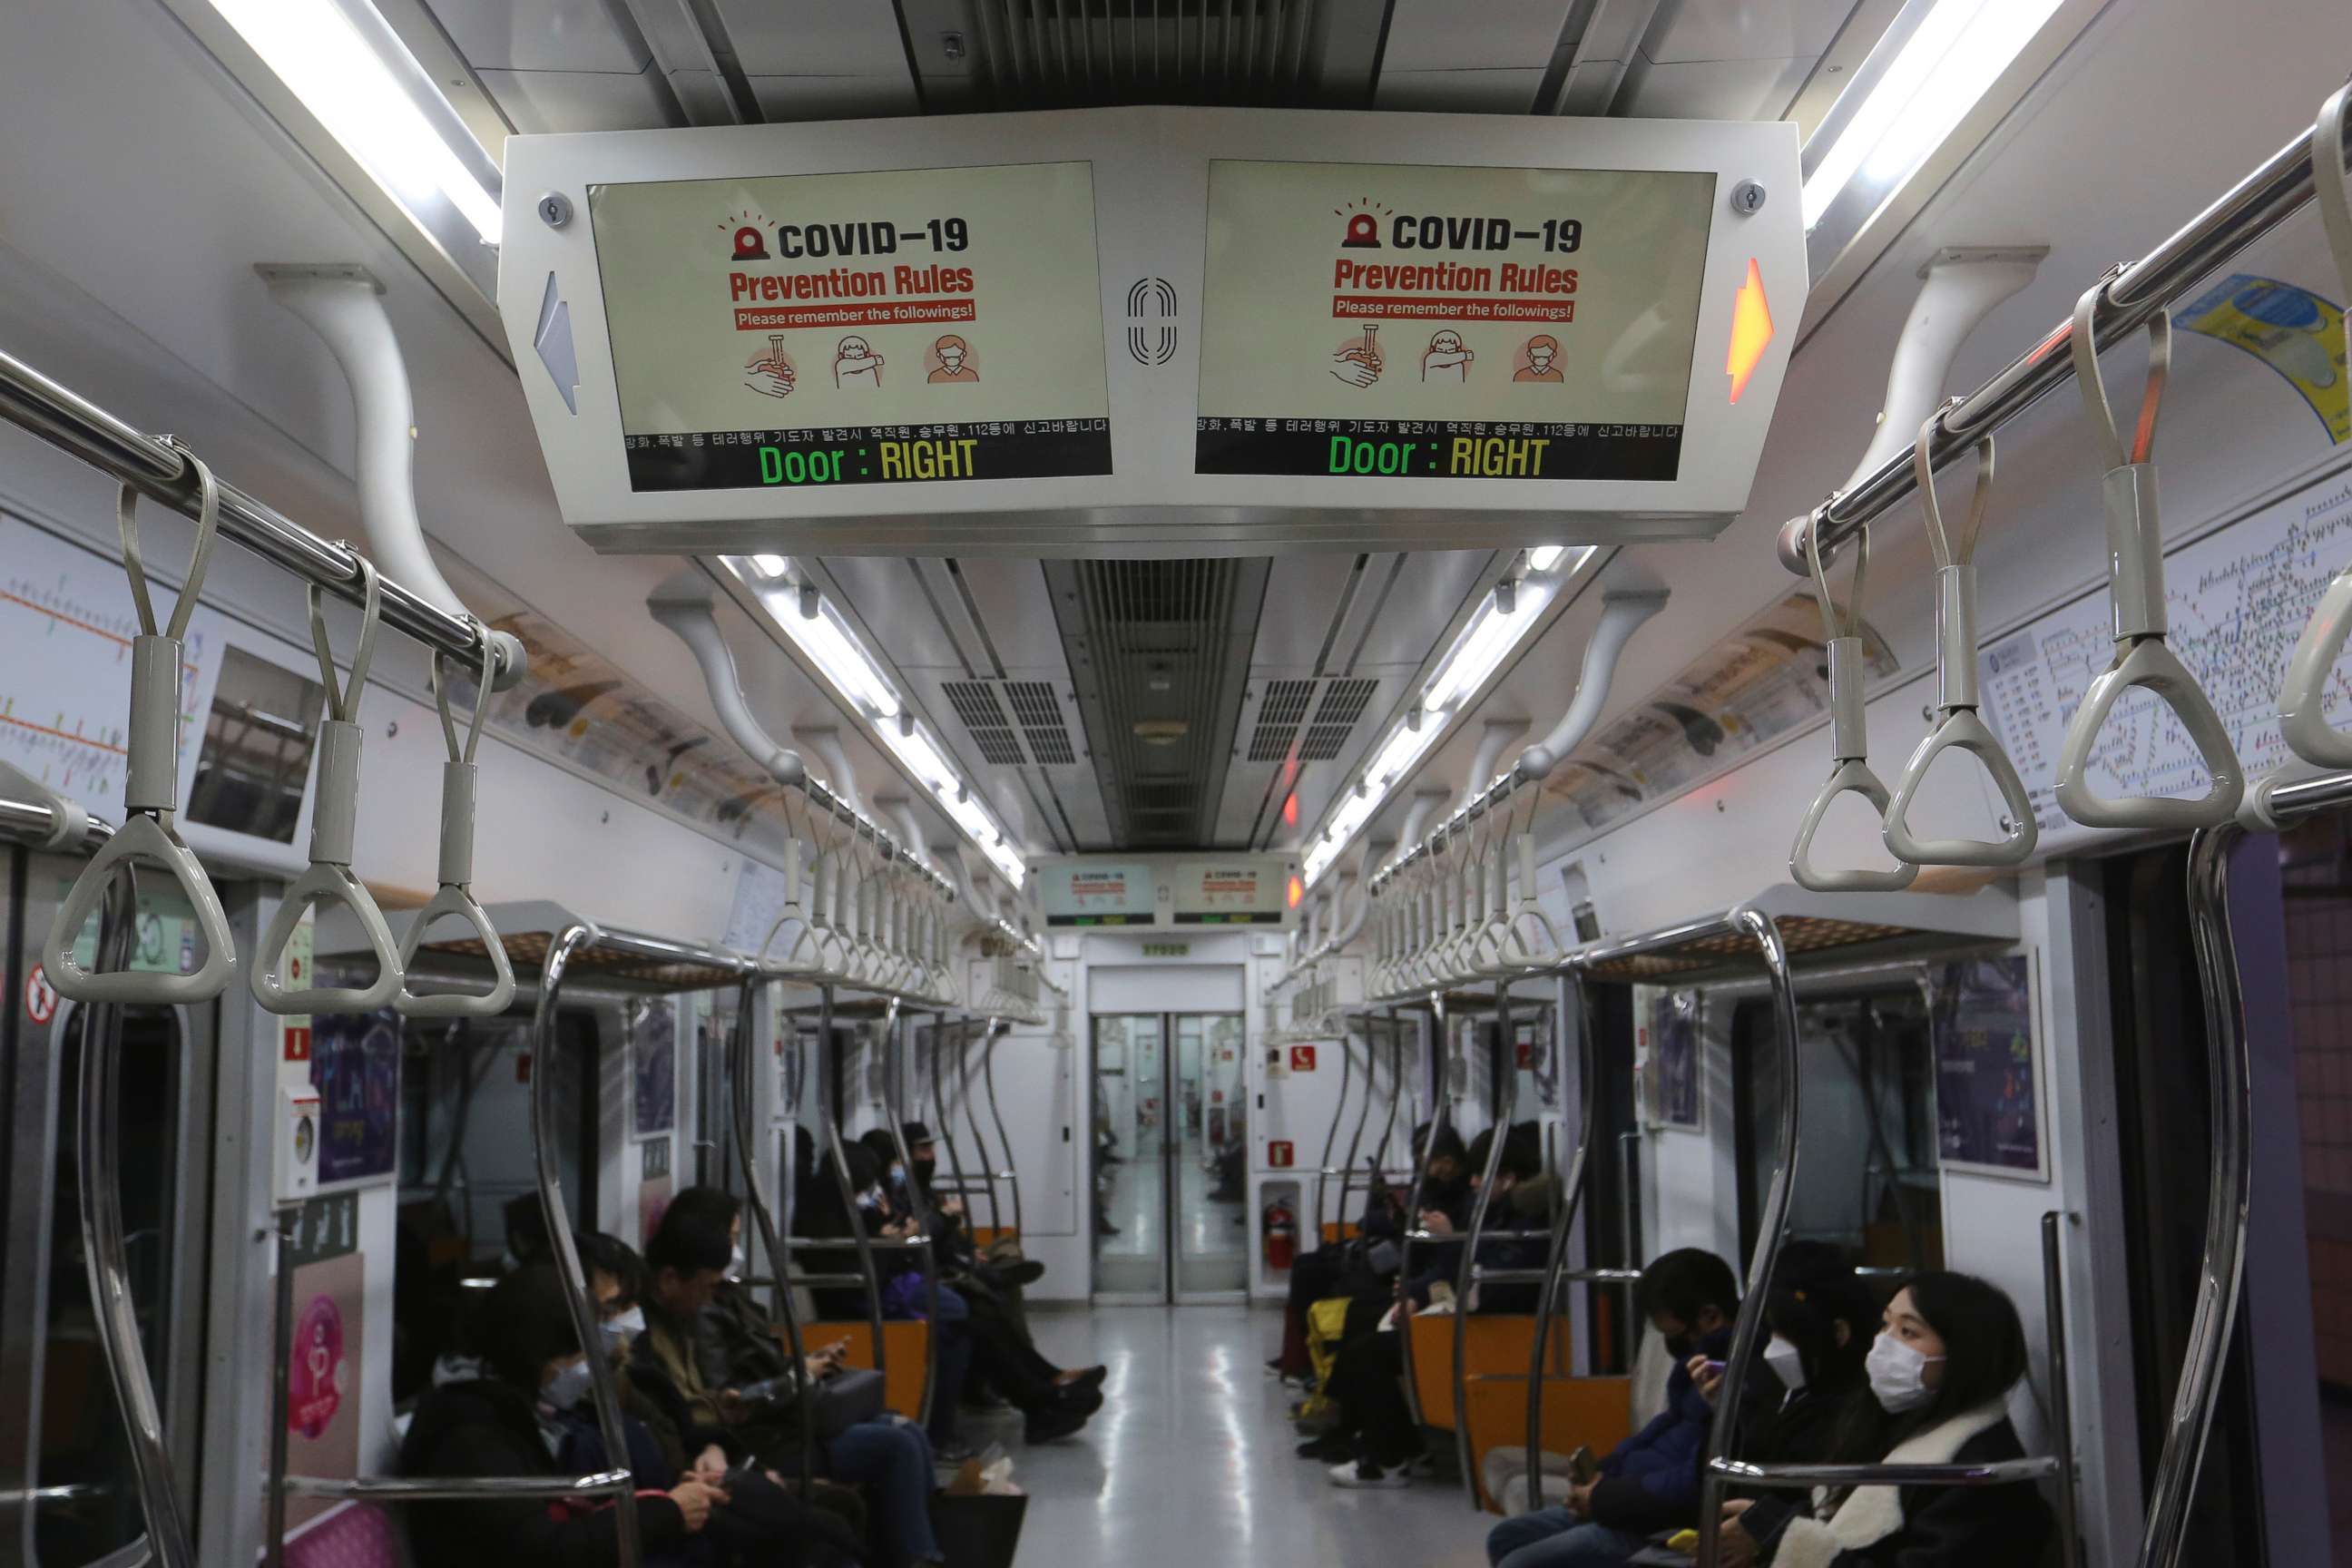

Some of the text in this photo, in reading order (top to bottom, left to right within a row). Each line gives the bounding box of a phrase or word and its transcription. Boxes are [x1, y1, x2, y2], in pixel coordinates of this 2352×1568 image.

[779, 217, 969, 260] COVID-19
[1391, 215, 1583, 253] COVID-19
[730, 265, 974, 301] Prevention Rules
[1335, 260, 1578, 293] Prevention Rules
[738, 303, 974, 326] Please remember the followings!
[1336, 300, 1573, 319] Please remember the followings!
[692, 433, 705, 447] 등
[712, 431, 766, 446] 테러행위
[773, 429, 814, 444] 기도자
[821, 427, 862, 442] 발견시
[1024, 418, 1107, 436] 신고바랍니다
[1264, 418, 1278, 433] 등
[1286, 419, 1340, 434] 테러행위
[1348, 420, 1389, 435] 기도자
[1397, 421, 1438, 436] 발견시
[1598, 424, 1679, 438] 신고바랍니다
[759, 446, 845, 485] Door
[879, 439, 975, 480] RIGHT
[1329, 436, 1416, 475] Door
[1450, 436, 1551, 476] RIGHT
